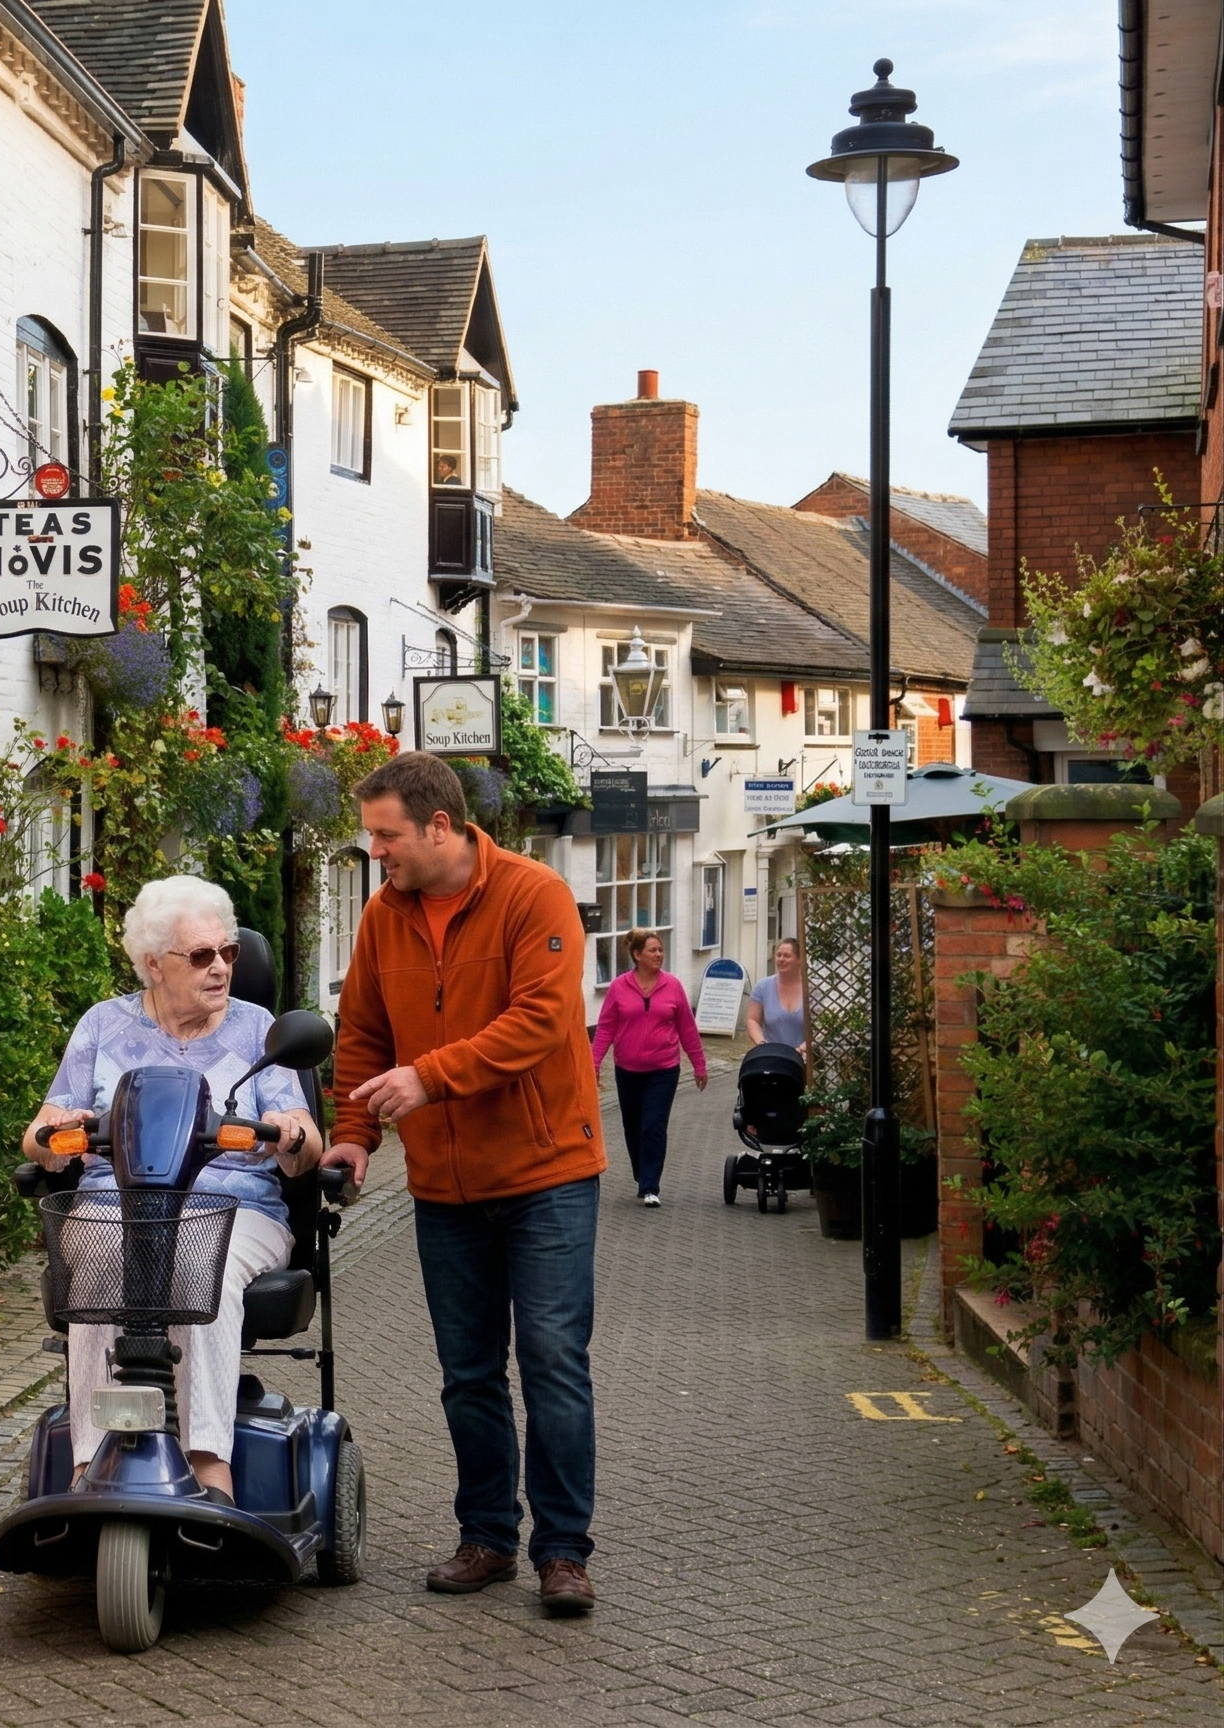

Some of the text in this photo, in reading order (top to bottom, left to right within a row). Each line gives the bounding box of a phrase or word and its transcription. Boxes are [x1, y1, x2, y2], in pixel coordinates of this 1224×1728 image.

[26, 580, 44, 590] The
[35, 592, 101, 623] Kitchen
[426, 731, 491, 747] Soup Kitchen
